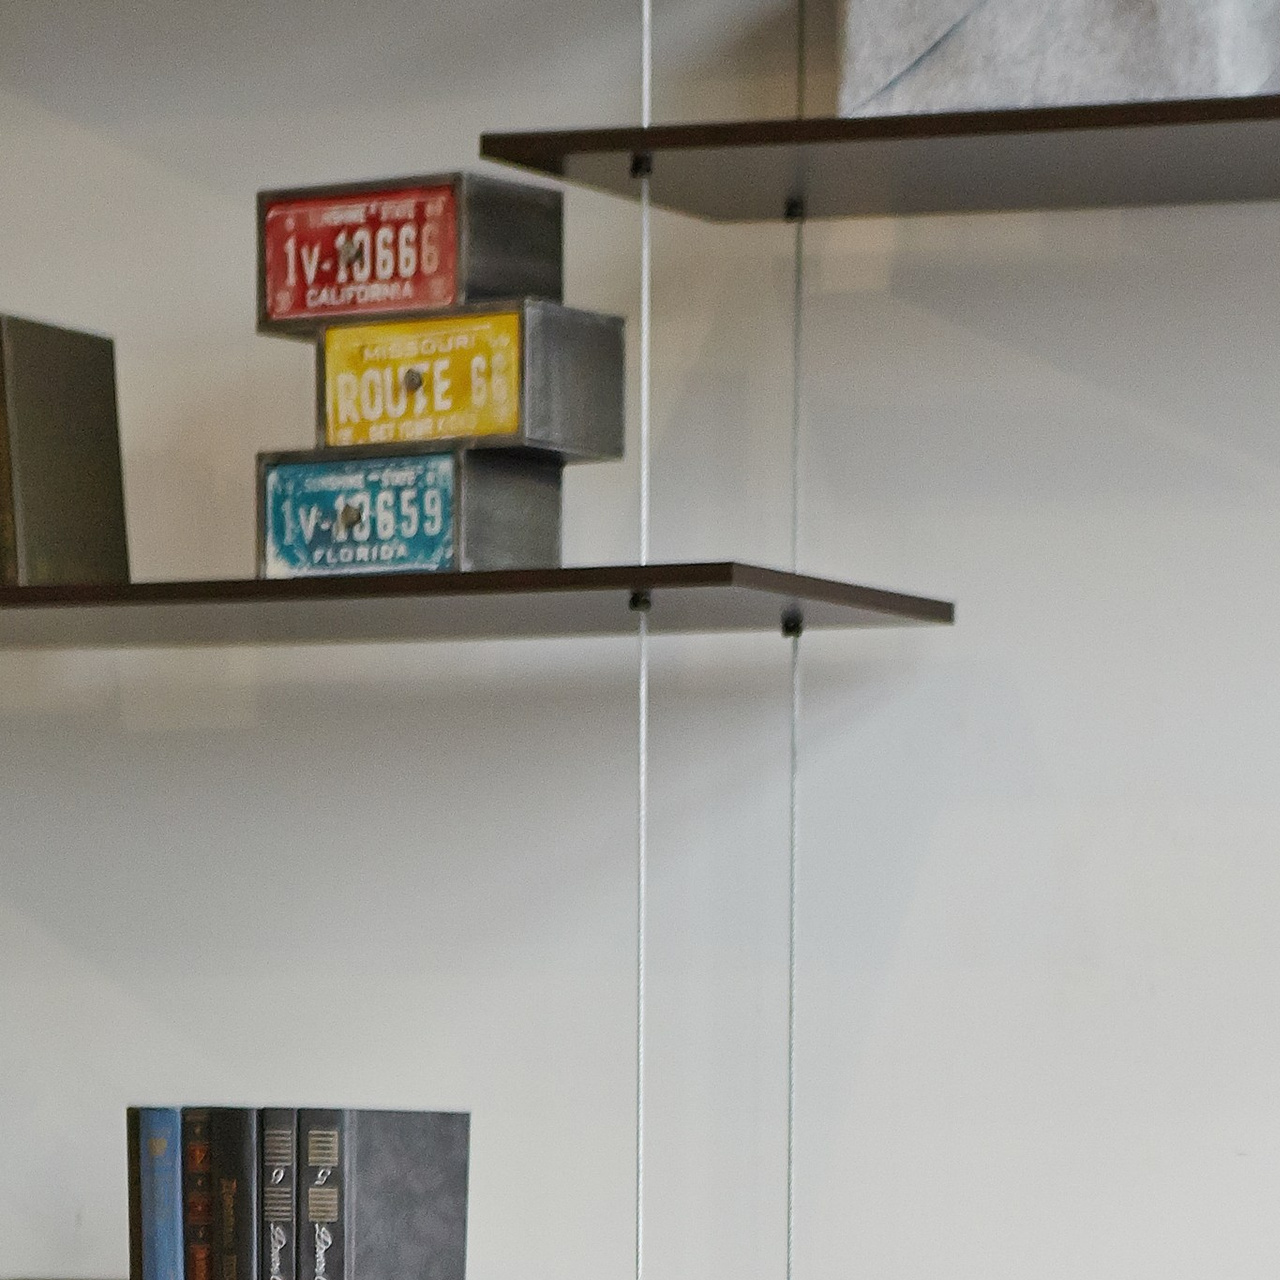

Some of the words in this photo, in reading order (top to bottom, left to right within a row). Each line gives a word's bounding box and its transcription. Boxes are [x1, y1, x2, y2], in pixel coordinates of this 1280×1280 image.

[306, 281, 412, 308] CALIFORNIA
[337, 359, 451, 424] ROUTE
[471, 353, 508, 409] 66
[313, 543, 407, 564] FLORIDA
